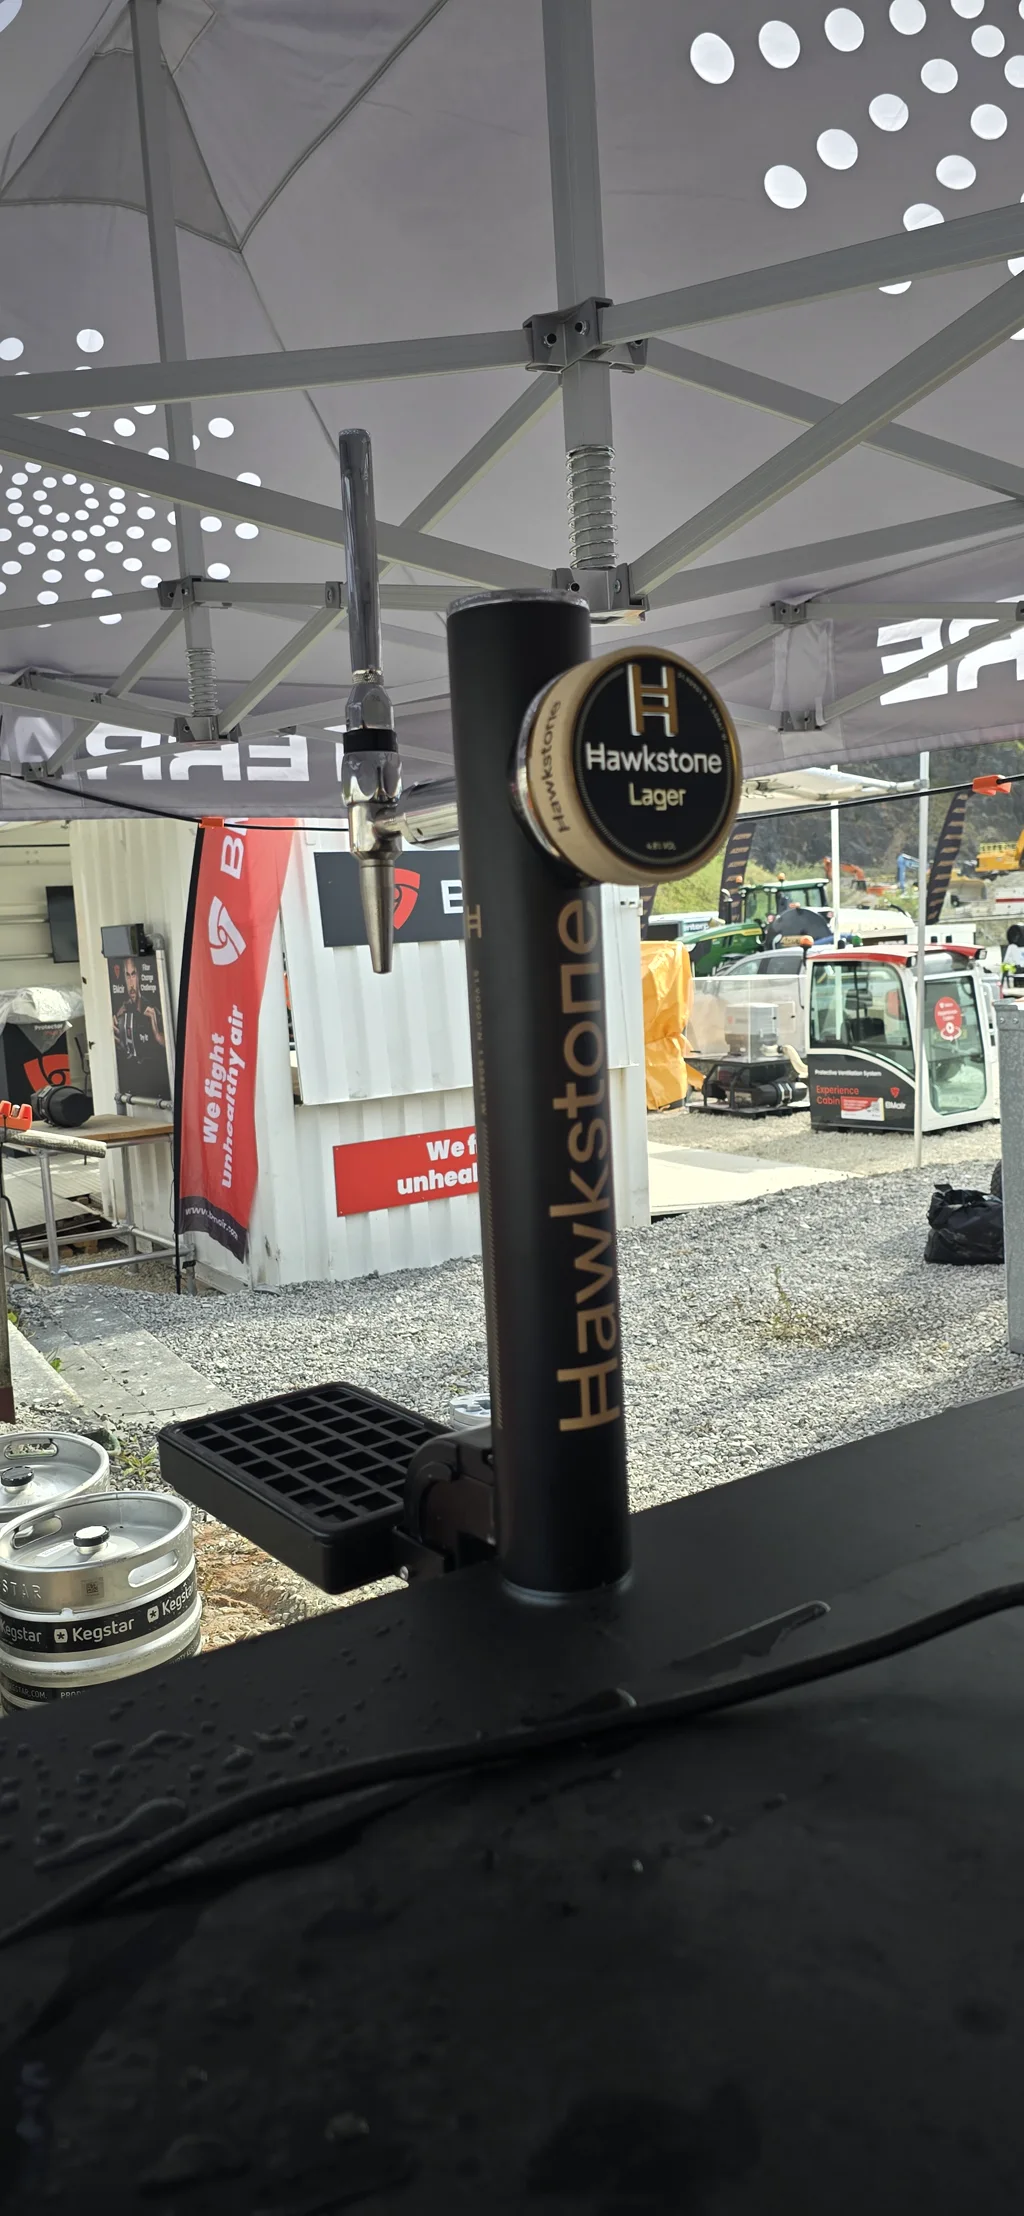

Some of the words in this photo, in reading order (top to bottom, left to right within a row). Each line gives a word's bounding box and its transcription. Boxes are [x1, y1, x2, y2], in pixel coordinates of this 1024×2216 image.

[541, 700, 571, 833] Hawkstone
[585, 742, 722, 774] Hawkstone
[629, 782, 686, 811] Lager
[229, 1004, 246, 1045] air
[204, 1032, 227, 1099] fight
[838, 1069, 863, 1077] Ventilation
[864, 1070, 882, 1078] System
[816, 1085, 860, 1095] Experience
[816, 1096, 840, 1105] Cabin
[203, 1103, 222, 1145] We
[221, 1048, 247, 1188] unhealthy
[426, 1139, 465, 1162] We
[549, 897, 621, 1432] Hawkstone
[161, 1581, 194, 1616] Kegstar
[72, 1617, 135, 1643] Kegstar
